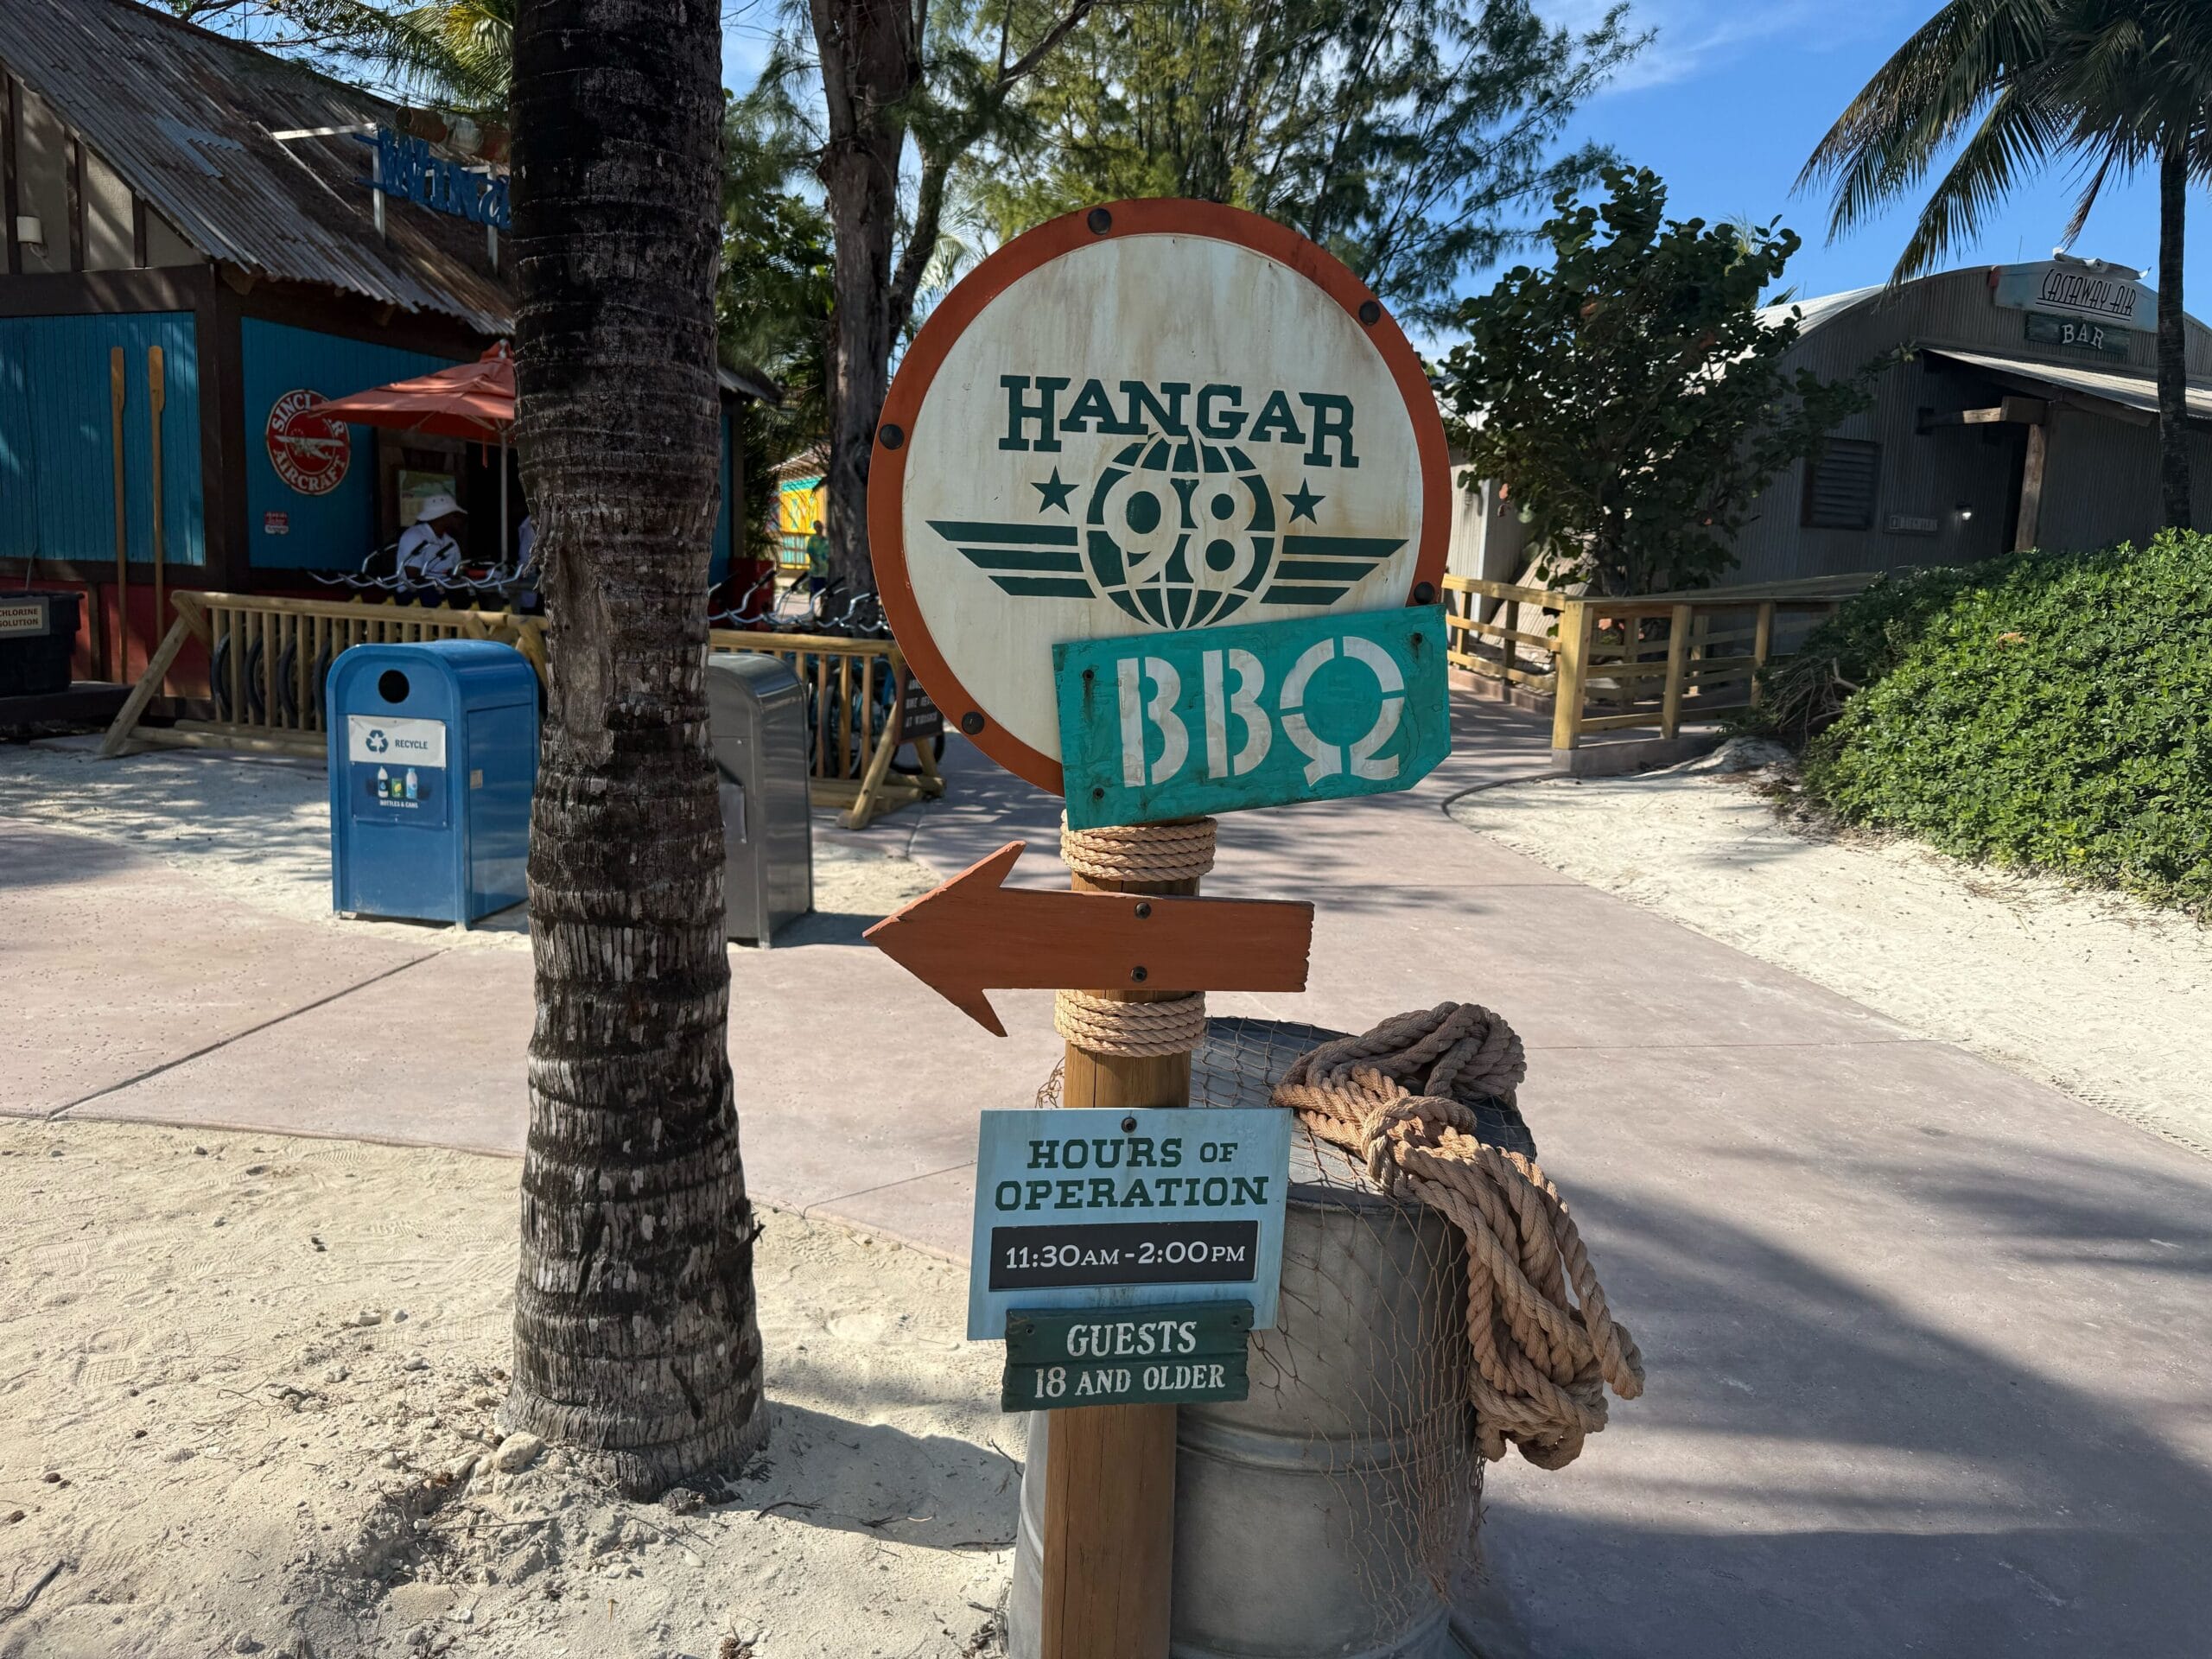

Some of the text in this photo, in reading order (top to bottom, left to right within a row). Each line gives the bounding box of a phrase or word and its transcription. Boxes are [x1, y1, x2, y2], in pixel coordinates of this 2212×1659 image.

[2042, 269, 2137, 316] CASTAWAY AIR
[2062, 323, 2104, 350] BAR
[271, 393, 346, 437] SINCLR
[998, 374, 1360, 468] HANGAR
[273, 448, 346, 492] AIRCRAFT
[1103, 473, 1256, 592] 98
[1117, 636, 1405, 788] BBQ
[395, 739, 429, 750] RECYCLE
[379, 799, 400, 808] BOTTLES
[405, 801, 419, 810] CANS
[1027, 1137, 1238, 1169] HOURS OF
[995, 1176, 1269, 1211] OPERATION
[1066, 1320, 1198, 1357] GUESTS
[1035, 1363, 1226, 1399] 18 AND OLDER
